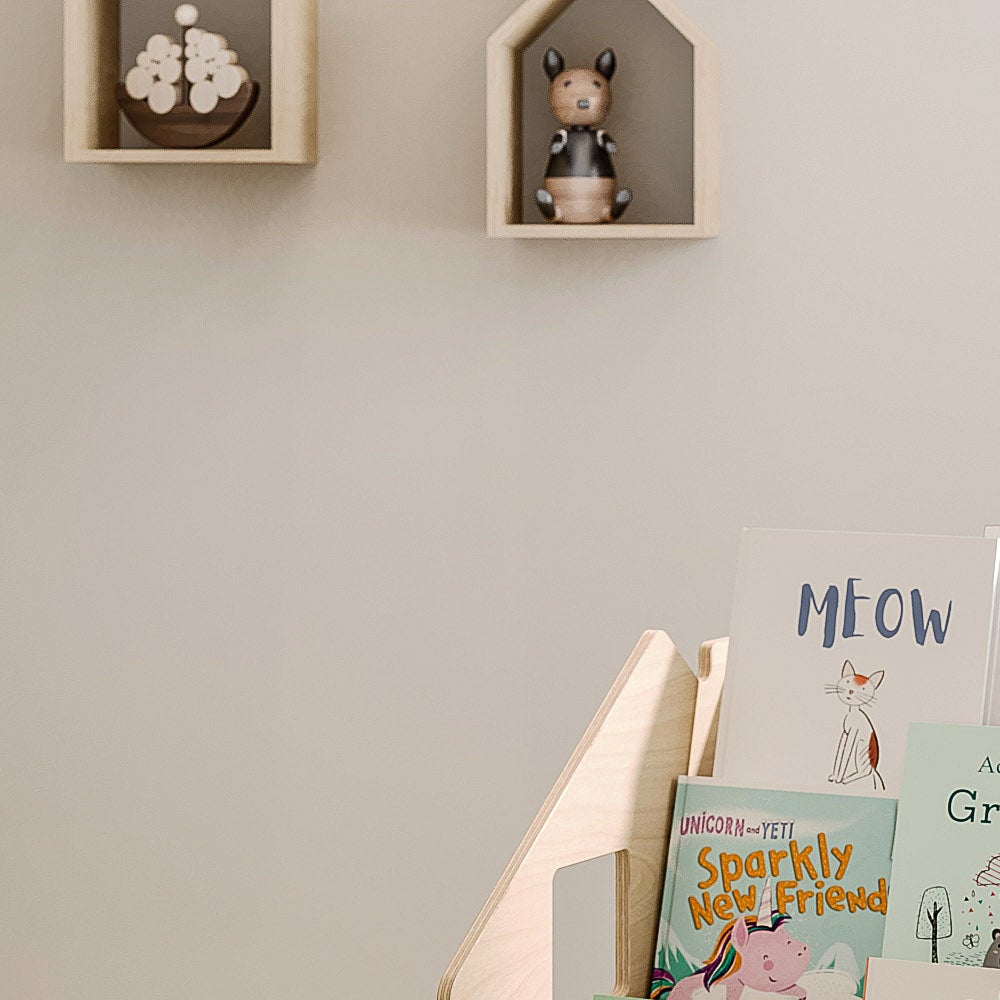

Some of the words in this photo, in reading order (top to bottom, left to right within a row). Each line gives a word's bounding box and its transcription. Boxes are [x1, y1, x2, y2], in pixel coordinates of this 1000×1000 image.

[797, 576, 953, 648] MEOW
[746, 824, 760, 834] and
[762, 821, 794, 840] YETI
[697, 832, 853, 893] Sparkly
[688, 885, 757, 931] New
[776, 877, 890, 916] Friend
